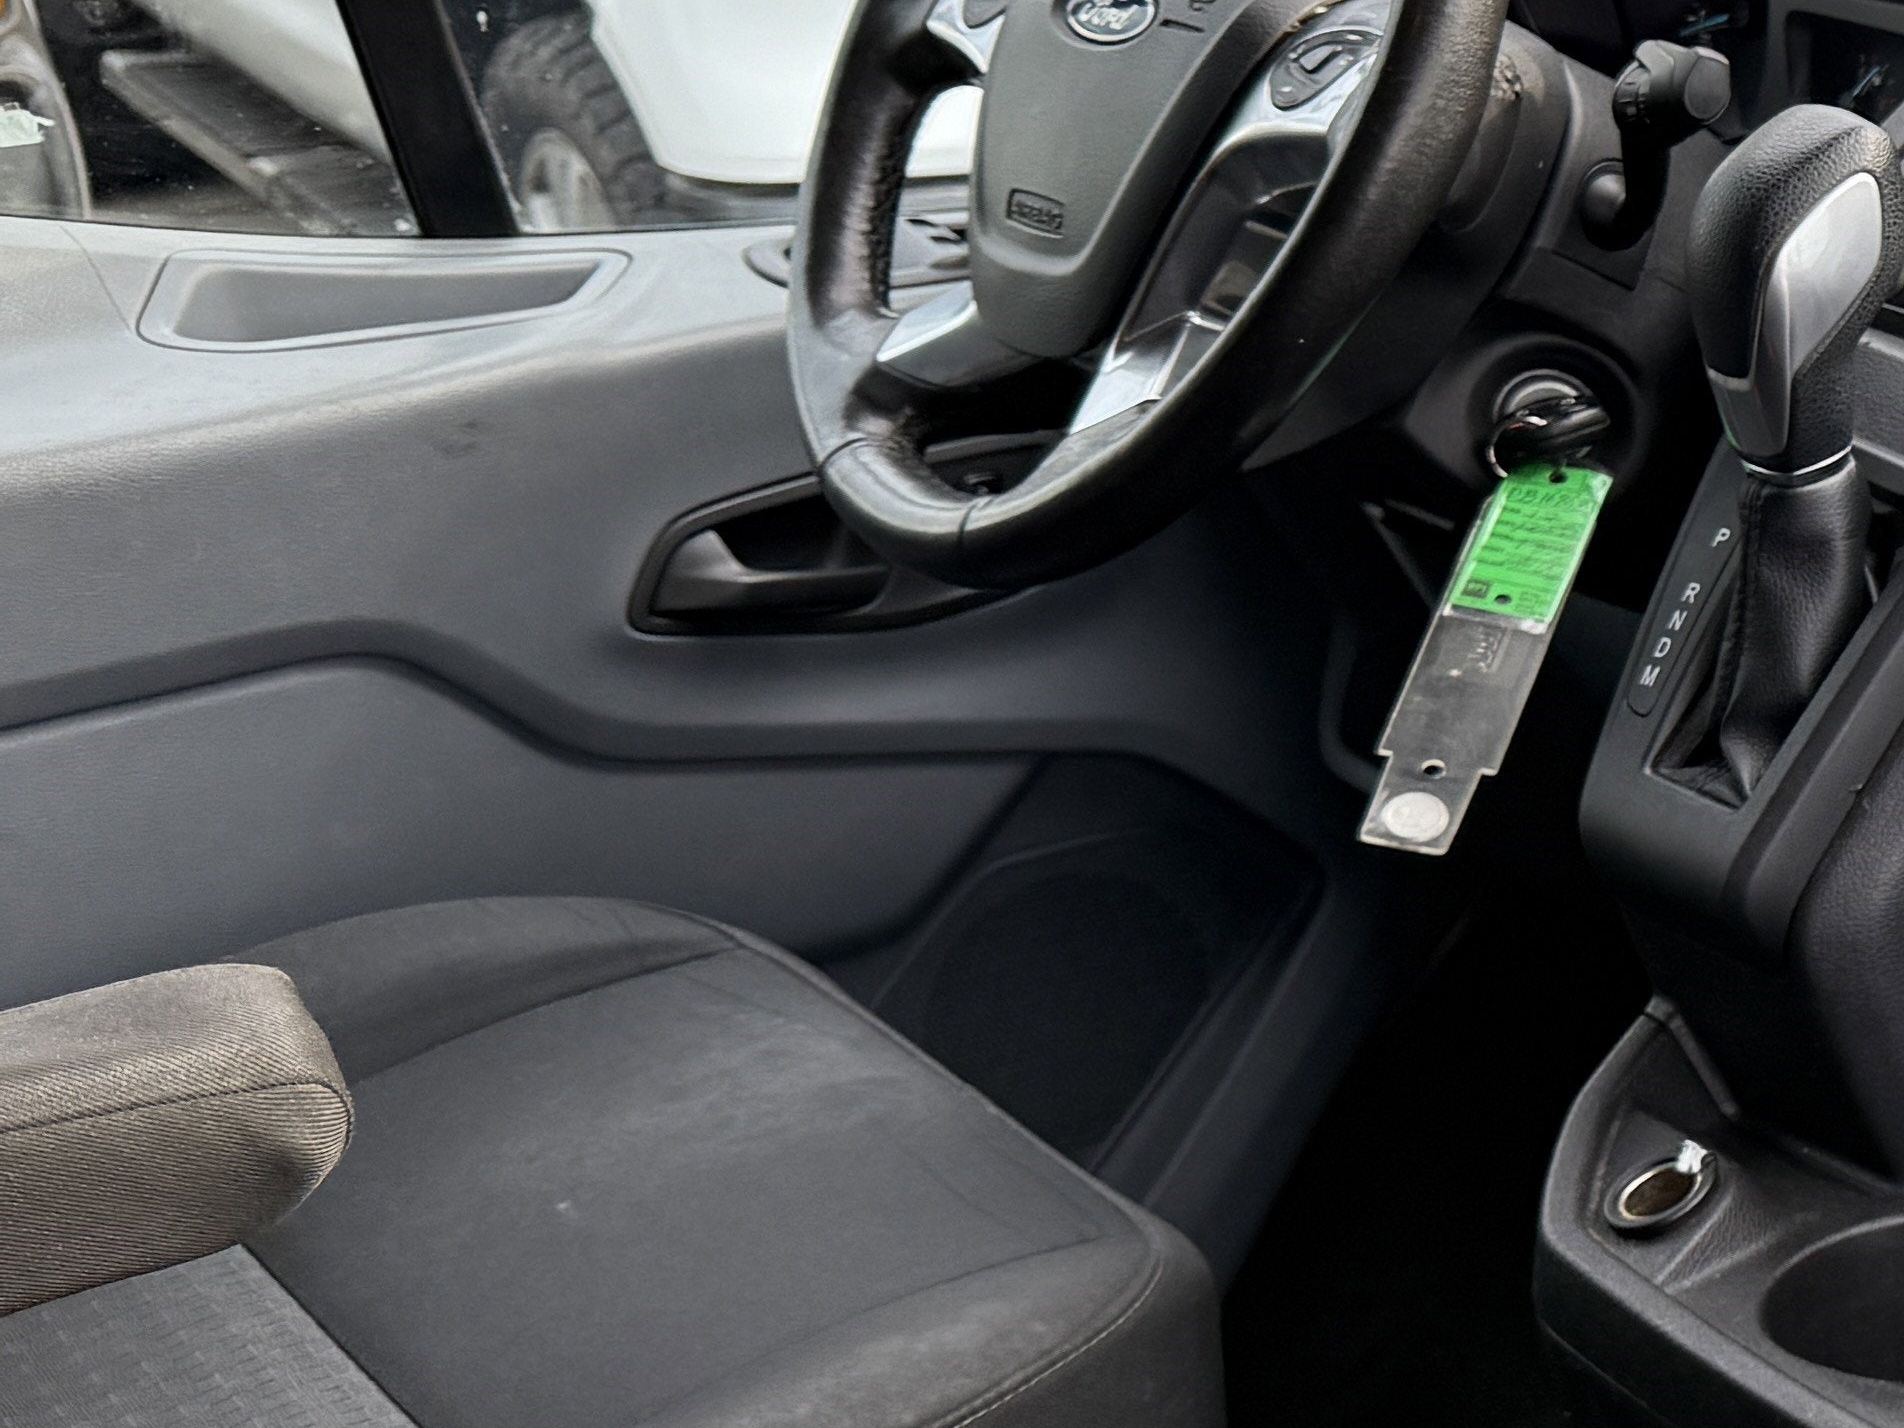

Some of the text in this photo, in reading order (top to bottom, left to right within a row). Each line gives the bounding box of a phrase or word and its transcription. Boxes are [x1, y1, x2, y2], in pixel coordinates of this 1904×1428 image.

[1710, 526, 1732, 548] P
[1680, 582, 1701, 604] R
[1667, 609, 1689, 631] N
[1653, 636, 1673, 658] D
[1639, 664, 1661, 687] M
